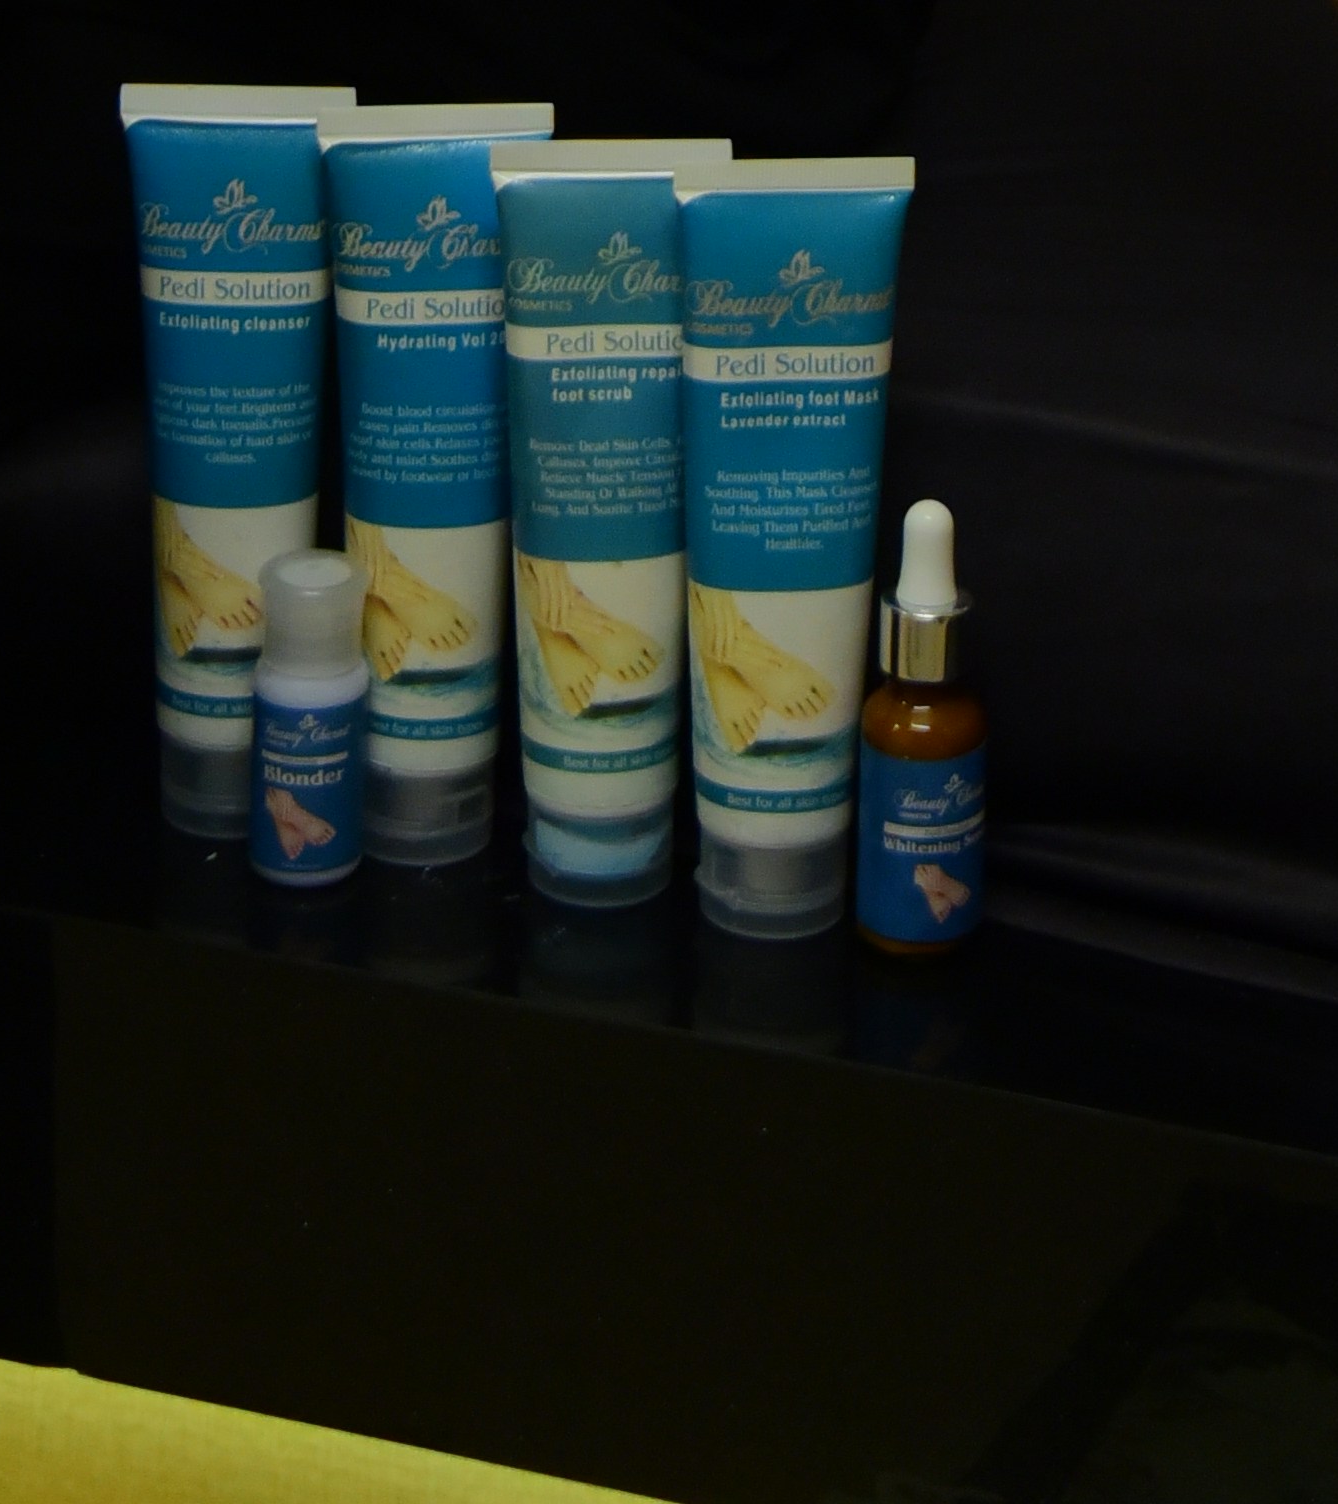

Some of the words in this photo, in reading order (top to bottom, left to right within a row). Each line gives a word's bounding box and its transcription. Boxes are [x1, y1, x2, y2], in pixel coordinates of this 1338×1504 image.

[140, 202, 225, 255] Beauty
[333, 222, 429, 272] Beauty
[161, 276, 205, 299] Pedi
[215, 278, 310, 300] Solution
[507, 257, 610, 304] Beauty
[366, 298, 415, 319] Pedi
[424, 296, 505, 318] Solutio
[686, 280, 791, 328] Beauty
[160, 312, 240, 335] Exfoliating
[244, 316, 310, 332] cleanser
[377, 333, 456, 352] Hydrating
[461, 332, 485, 347] Vol
[546, 331, 594, 354] Pedi
[551, 366, 637, 383] Exfoliating
[642, 367, 683, 381] repai
[716, 353, 765, 376] Pedi
[775, 353, 874, 375] Solution
[553, 388, 584, 402] foot
[589, 386, 632, 401] scrub
[720, 391, 804, 410] Exfoliating
[809, 391, 840, 406] foot
[844, 388, 879, 405] Mask
[721, 414, 790, 428] Lavender
[793, 413, 846, 427] extract
[264, 763, 345, 785] Blonder
[883, 835, 960, 853] Whitening
